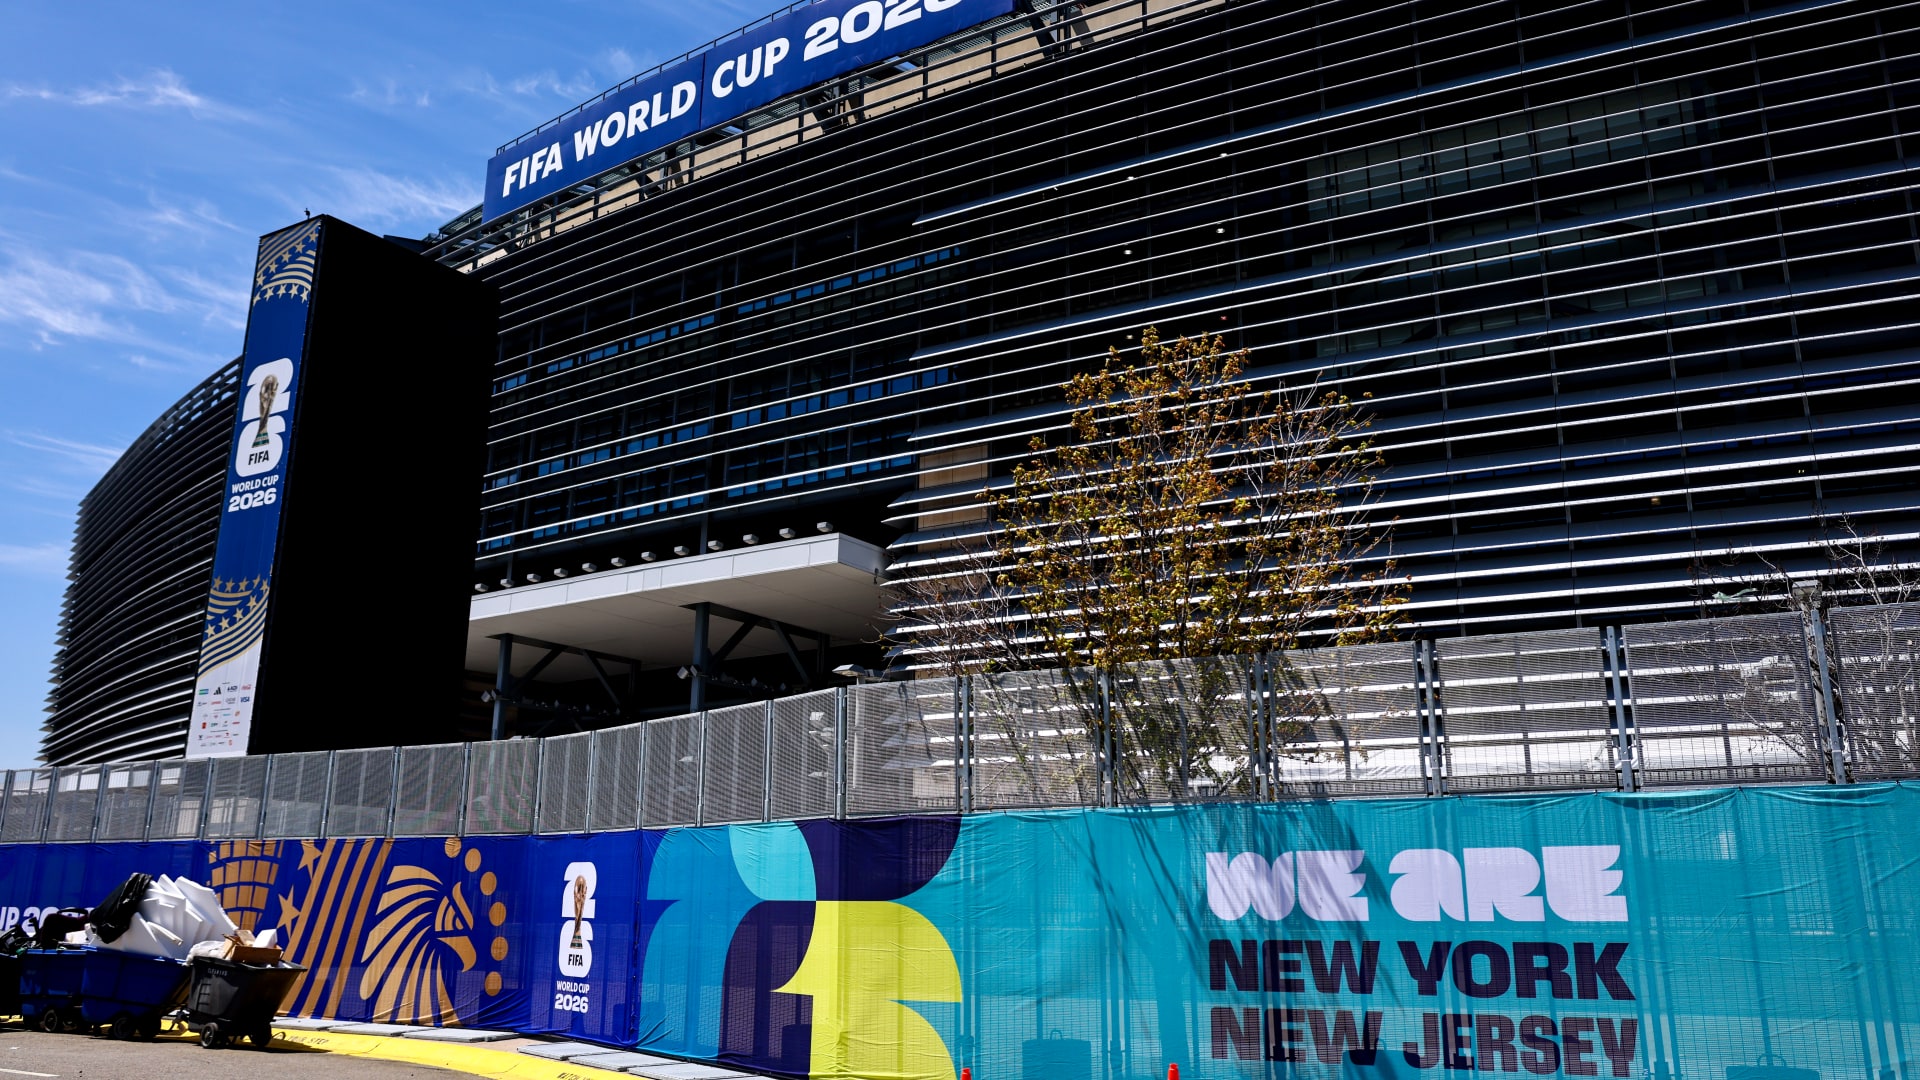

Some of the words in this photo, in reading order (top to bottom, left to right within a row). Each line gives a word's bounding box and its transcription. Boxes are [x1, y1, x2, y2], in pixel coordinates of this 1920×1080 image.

[502, 143, 562, 197] FIFA
[573, 80, 696, 162] WORLD
[711, 37, 789, 98] CUP
[248, 450, 270, 466] FIFA
[231, 479, 261, 494] WORLD
[262, 475, 279, 488] CUP
[228, 487, 277, 512] 2026
[1206, 850, 1369, 921] WE
[568, 954, 583, 967] FIFA
[1209, 939, 1380, 994] NEW
[1397, 940, 1637, 1000] YORK
[556, 980, 578, 993] WORLD
[578, 982, 590, 994] CUP
[554, 993, 589, 1014] 2026
[1210, 1006, 1383, 1066] NEW
[1402, 1013, 1638, 1077] JERSEY
